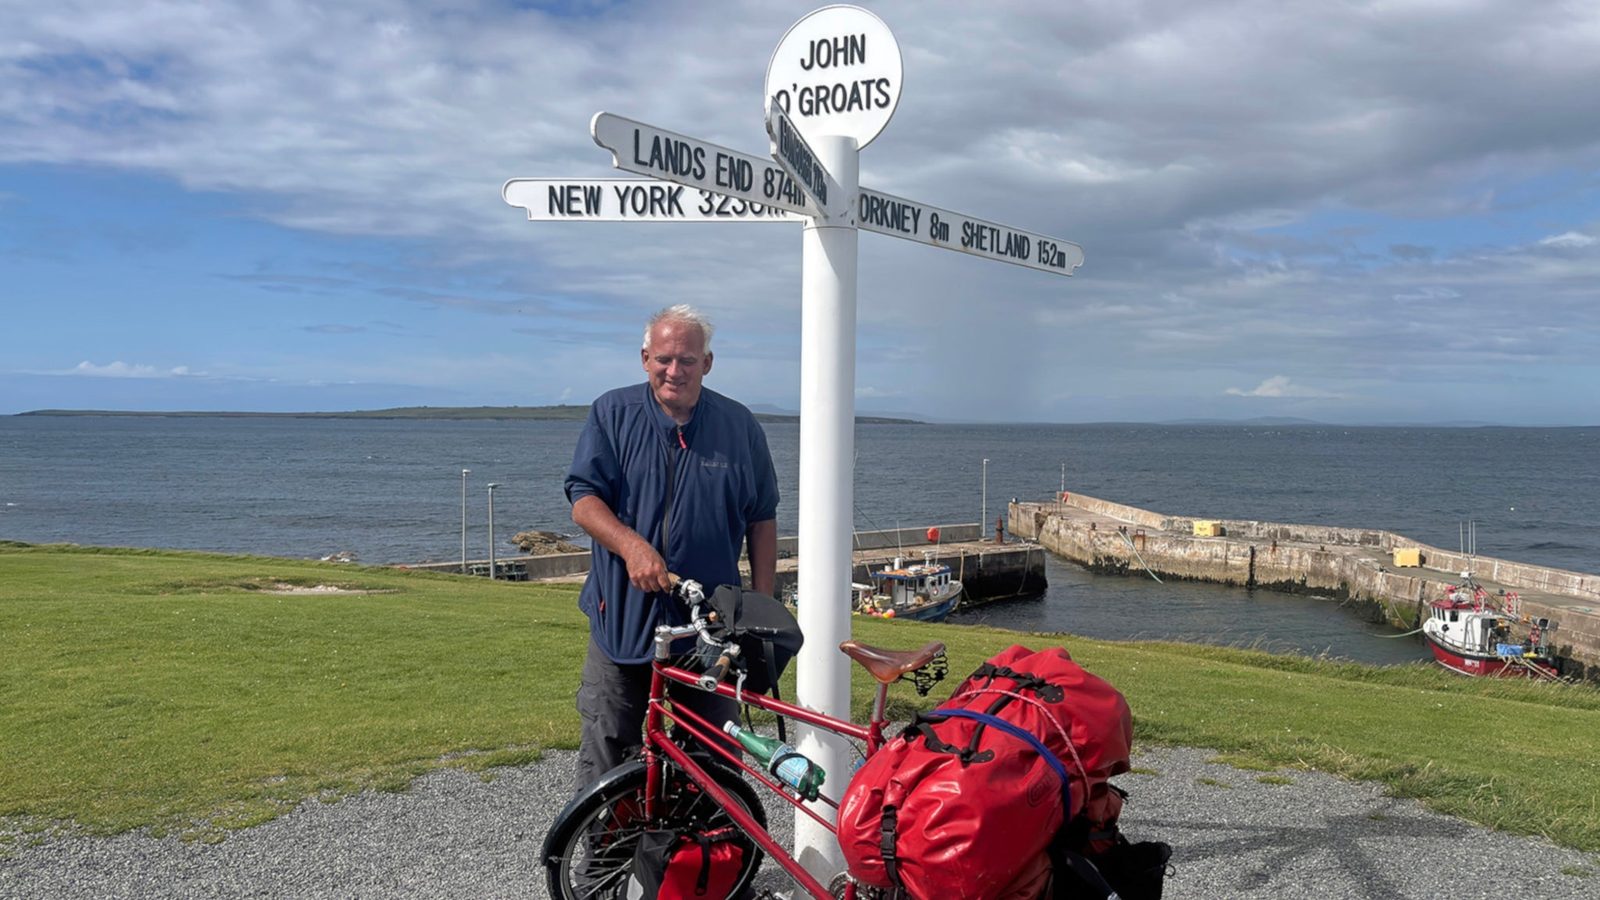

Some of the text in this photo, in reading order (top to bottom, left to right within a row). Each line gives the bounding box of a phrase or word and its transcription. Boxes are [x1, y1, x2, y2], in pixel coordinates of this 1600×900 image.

[800, 33, 866, 71] JOHN
[775, 77, 891, 117] O'GROATS
[634, 129, 706, 180] LANDS
[716, 152, 753, 192] END
[548, 185, 602, 216] NEW
[614, 185, 685, 217] YORK
[859, 193, 1066, 269] ORKNEY 8m SHETLAND 152m
